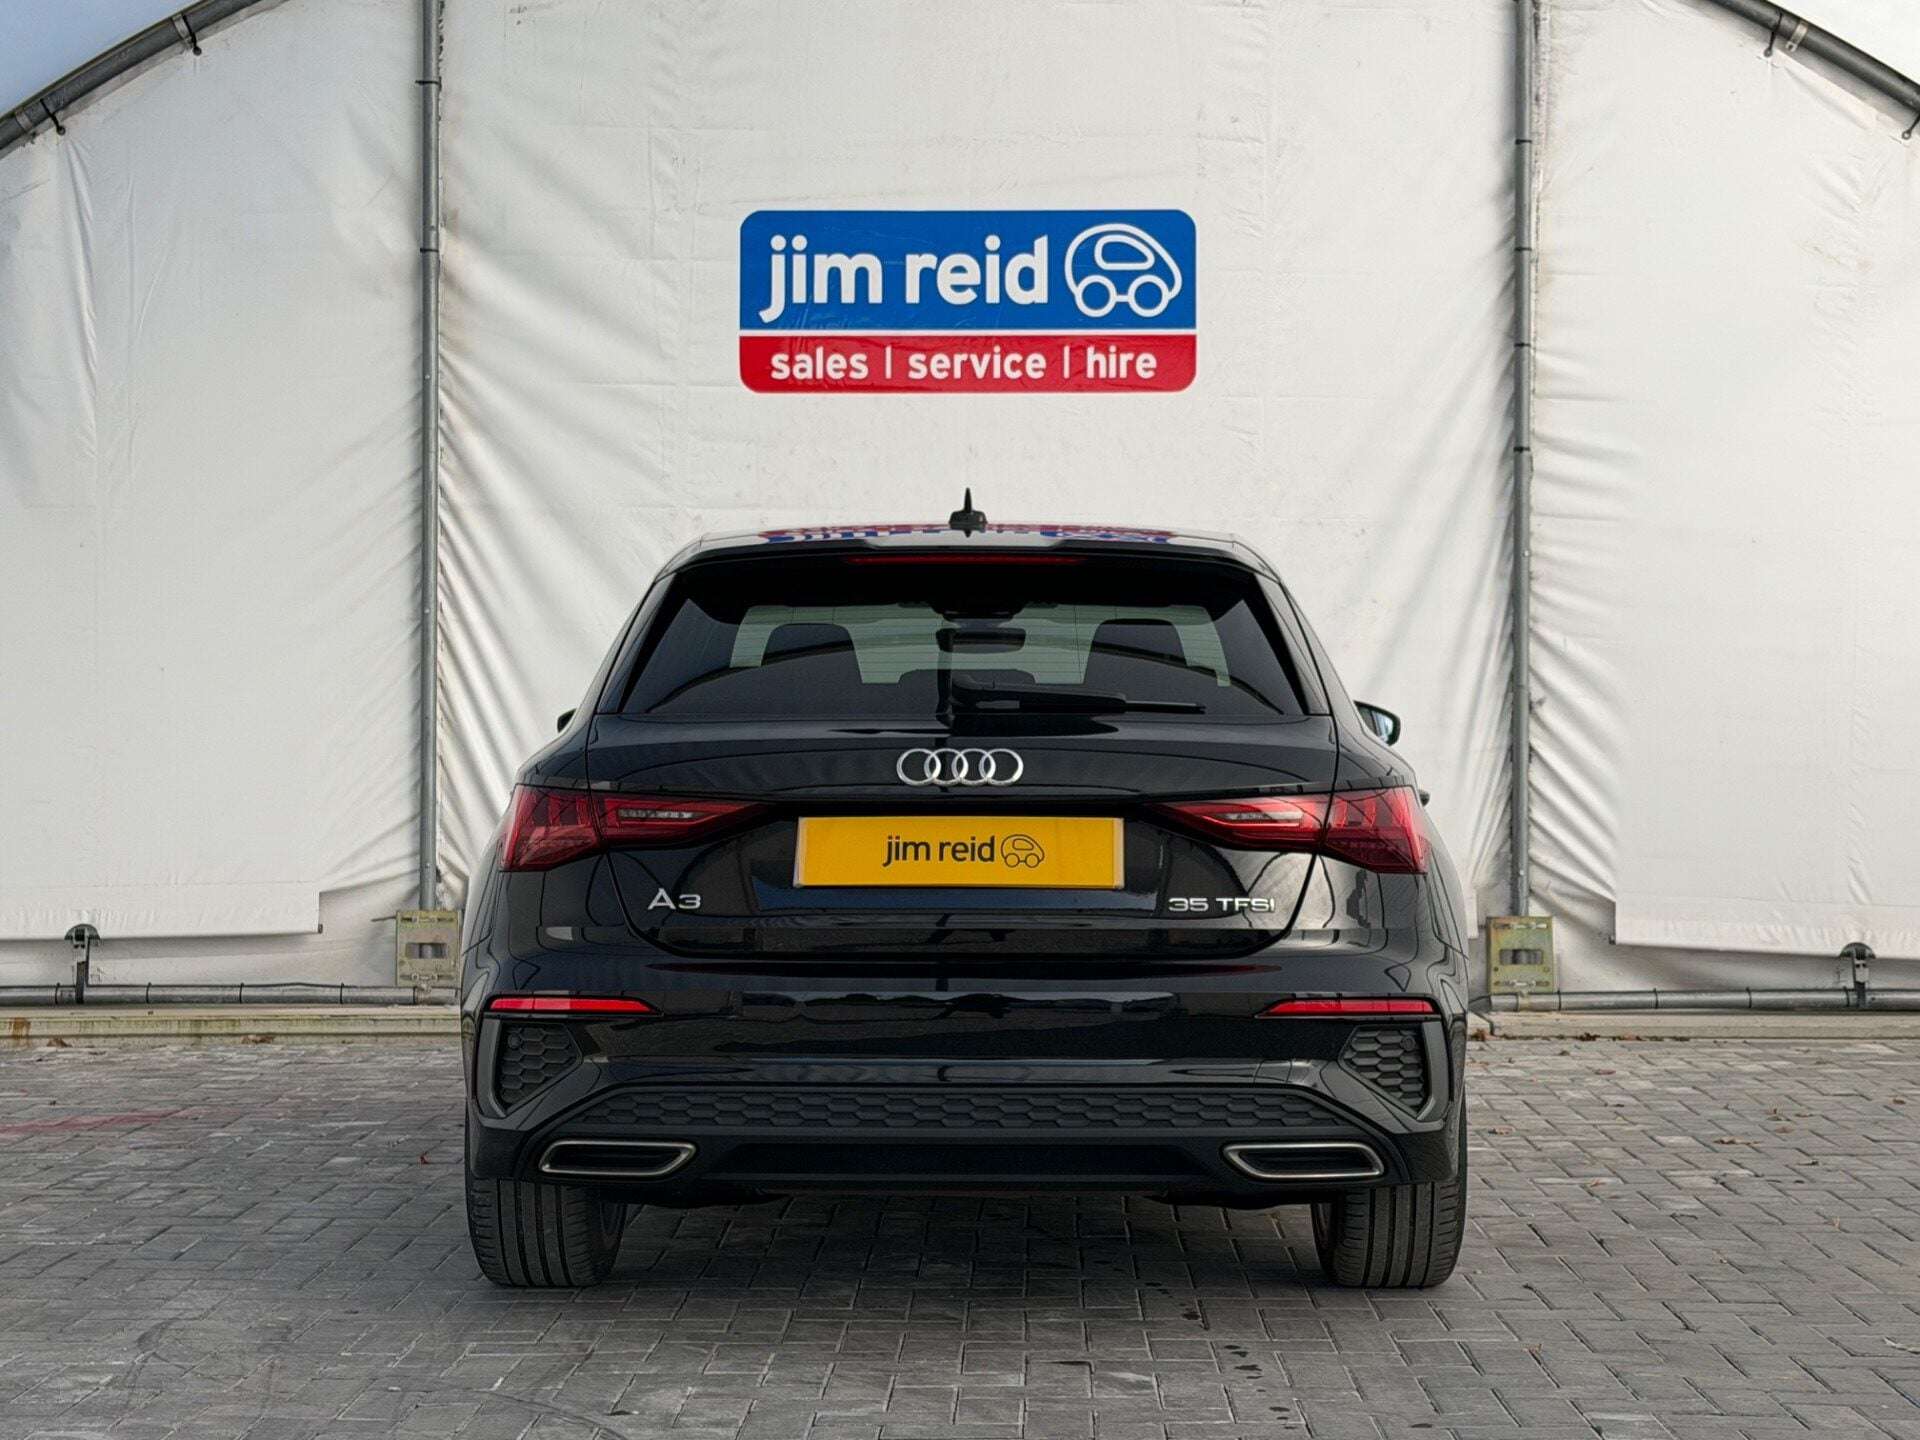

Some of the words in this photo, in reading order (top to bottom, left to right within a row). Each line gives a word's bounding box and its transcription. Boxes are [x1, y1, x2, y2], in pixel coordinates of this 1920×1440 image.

[758, 234, 882, 324] jim
[905, 234, 1048, 305] reid
[770, 346, 869, 380] sales
[908, 345, 1046, 380] service
[1086, 345, 1157, 380] hire
[882, 835, 931, 867] jim
[938, 835, 995, 862] reid
[647, 887, 701, 910] A3
[1168, 897, 1209, 912] 35
[1215, 897, 1275, 912] TFSI
